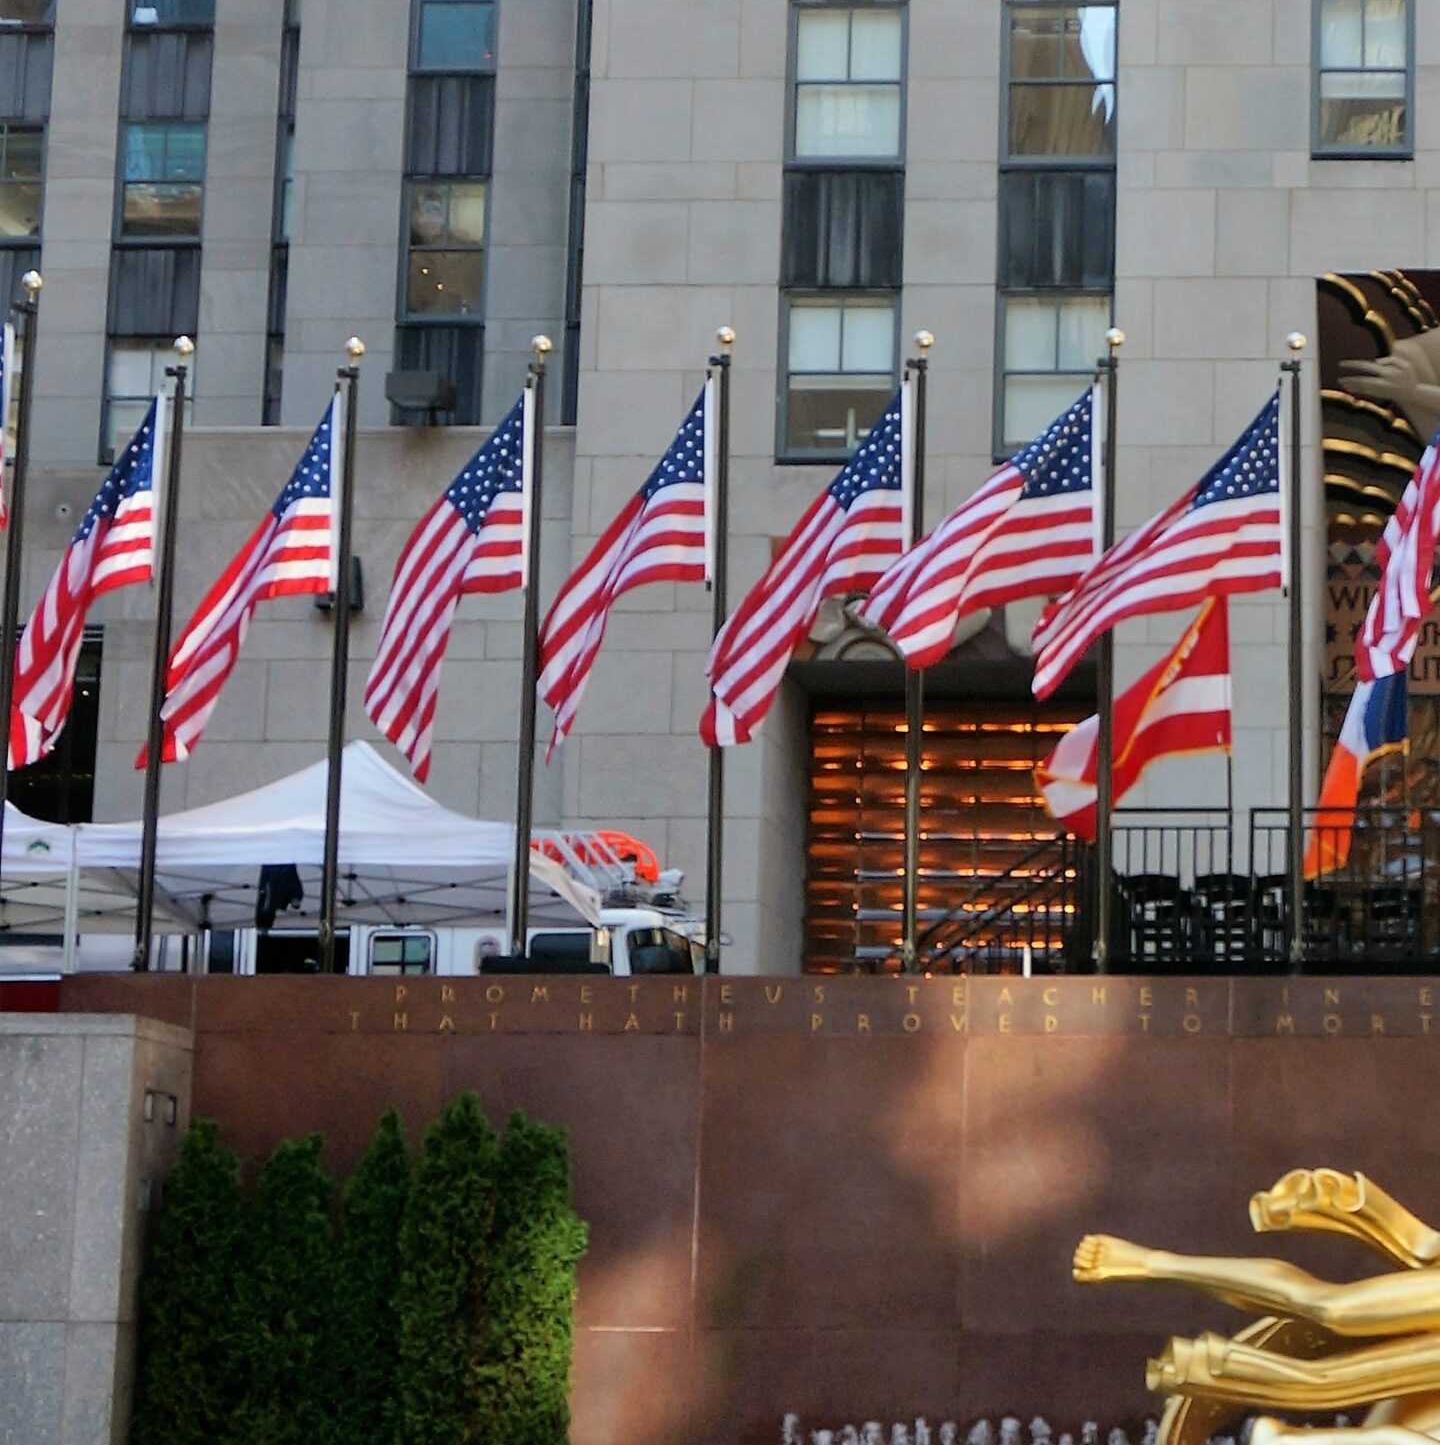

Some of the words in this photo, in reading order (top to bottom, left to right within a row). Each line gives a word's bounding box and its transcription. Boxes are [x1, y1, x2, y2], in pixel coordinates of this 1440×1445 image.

[906, 986, 1198, 1006] TEACHER
[1282, 987, 1341, 1005] IN
[350, 1012, 500, 1030] THAT
[578, 1012, 734, 1031] HATH
[811, 1012, 1059, 1033] PROVED
[1139, 1014, 1202, 1033] TO
